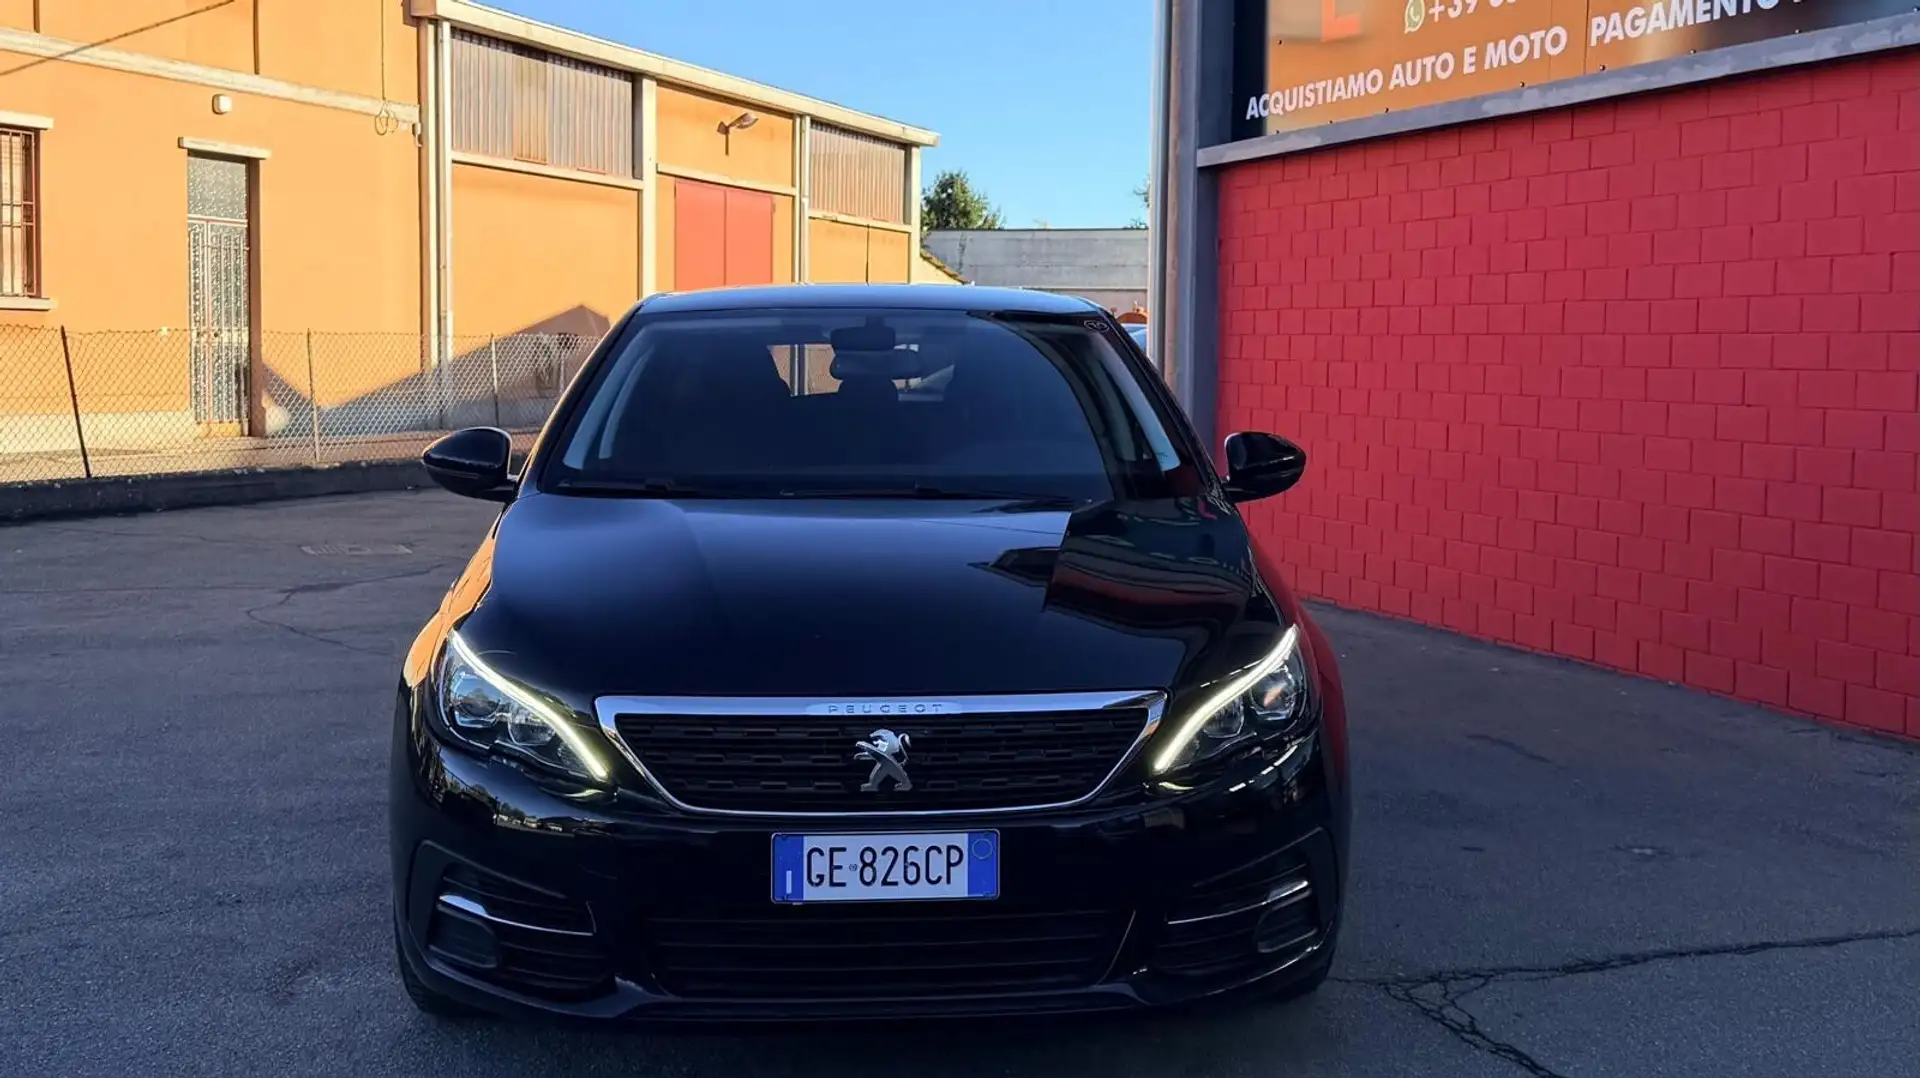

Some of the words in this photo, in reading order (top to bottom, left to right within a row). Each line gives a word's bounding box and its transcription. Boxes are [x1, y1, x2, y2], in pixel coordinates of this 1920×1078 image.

[1246, 69, 1384, 120] ACQUISTIAMO
[1388, 52, 1455, 90] AUTO
[1463, 46, 1477, 75] E
[1484, 26, 1567, 70] MOTO
[828, 703, 942, 714] PEUGEOT
[807, 847, 847, 887] GE
[859, 845, 964, 886] 826CP
